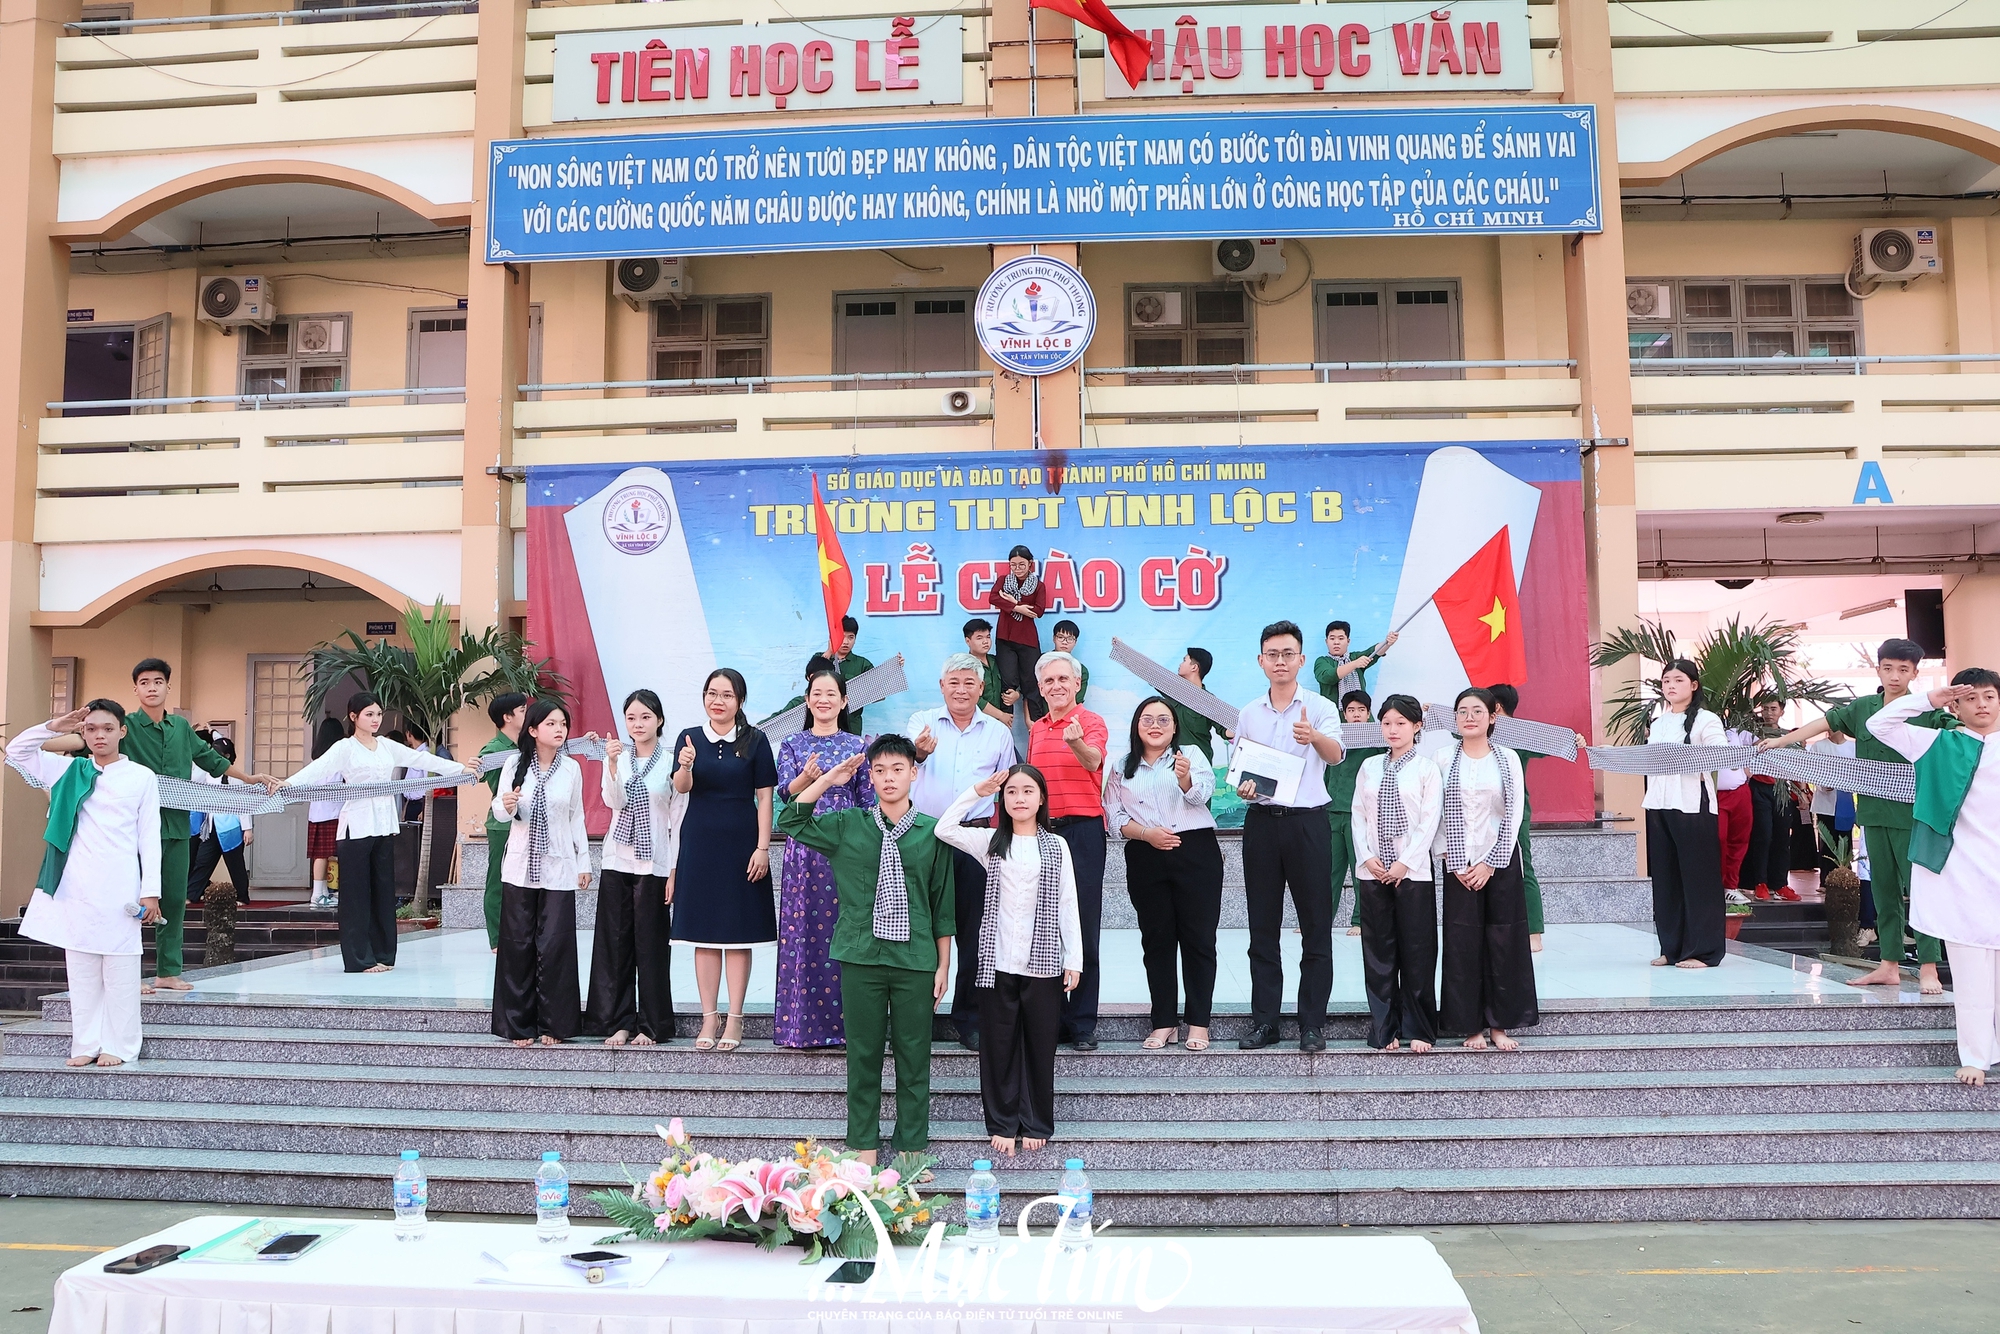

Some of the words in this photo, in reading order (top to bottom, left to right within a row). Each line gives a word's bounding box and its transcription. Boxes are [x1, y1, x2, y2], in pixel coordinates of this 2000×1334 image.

[590, 38, 711, 104] TIÊN
[729, 40, 834, 109] HỌC
[855, 16, 920, 91] LỄ
[1264, 23, 1371, 91] HỌC
[1391, 9, 1502, 76] VĂN
[508, 163, 552, 190] "NON
[556, 155, 602, 189] SÔNG
[607, 153, 646, 190] VIỆT
[652, 157, 689, 184] NAM
[694, 149, 718, 182] CÓ
[723, 144, 760, 180] TRỞ
[765, 146, 801, 179] NÊN
[806, 146, 846, 177] TƯƠI
[851, 148, 888, 180] ĐẸP
[893, 147, 929, 174] HAY
[934, 138, 996, 172] KHÔNG
[1013, 136, 1050, 169] DÂN
[1055, 134, 1092, 173] TỘC
[1097, 133, 1137, 172] VIỆT
[1144, 139, 1183, 166] NAM
[1189, 131, 1214, 165] CÓ
[1219, 130, 1269, 164] BƯỚC
[1274, 129, 1305, 163] TỚI
[1310, 129, 1343, 162] ĐÀI
[1347, 134, 1390, 161] VINH
[1395, 133, 1456, 165] QUANG
[1461, 119, 1486, 160] ĐỂ
[1492, 126, 1541, 159] SÁNH
[1545, 131, 1576, 158] VAI
[522, 201, 551, 234] VỚI
[556, 199, 590, 233] CÁC
[595, 197, 653, 231] CƯỜNG
[658, 191, 705, 233] QUỐC
[710, 194, 749, 226] NĂM
[754, 190, 802, 224] CHÂU
[808, 190, 857, 227] ĐƯỢC
[862, 193, 897, 220] HAY
[903, 184, 970, 222] KHÔNG,
[975, 181, 1030, 217] CHÍNH
[1036, 180, 1060, 214] LÀ
[1066, 179, 1104, 214] NHỜ
[1110, 177, 1149, 217] MỘT
[1155, 172, 1205, 211] PHẦN
[1211, 175, 1247, 210] LỚN
[1252, 172, 1267, 209] Ở
[1271, 174, 1321, 209] CÔNG
[1326, 179, 1364, 213] HỌC
[1368, 172, 1405, 213] TẬP
[1410, 168, 1448, 206] CỦA
[1452, 171, 1489, 206] CÁC
[1494, 170, 1560, 206] CHÁU."
[1393, 204, 1425, 228] HỒ
[1434, 207, 1476, 227] CHÍ
[1482, 210, 1544, 226] MINH
[985, 280, 1007, 319] TRƯỜNG
[1004, 266, 1033, 283] TRUNG
[1035, 266, 1052, 277] HỌC
[1053, 272, 1073, 287] PHỔ
[1068, 283, 1087, 317] THÔNG
[1000, 337, 1031, 349] VĨNH
[1036, 336, 1059, 350] LỘC
[1064, 338, 1072, 348] B
[827, 467, 850, 491] SỞ
[855, 468, 895, 490] GIÁO
[901, 470, 936, 492] DỤC
[941, 466, 964, 488] VÀ
[969, 465, 1004, 487] ĐÀO
[1009, 467, 1042, 489] TẠO
[1111, 459, 1147, 483] PHỐ
[1152, 458, 1176, 482] HỒ
[1181, 459, 1211, 482] CHÍ
[1216, 462, 1267, 481] MINH
[1852, 461, 1894, 504] A
[949, 496, 1066, 531] THPT
[1077, 489, 1195, 528] VĨNH
[1209, 487, 1297, 532] LỘC
[1311, 490, 1343, 523] B
[636, 532, 650, 540] LỘC
[863, 541, 942, 616] LỄ
[1139, 543, 1229, 612] CỜ
